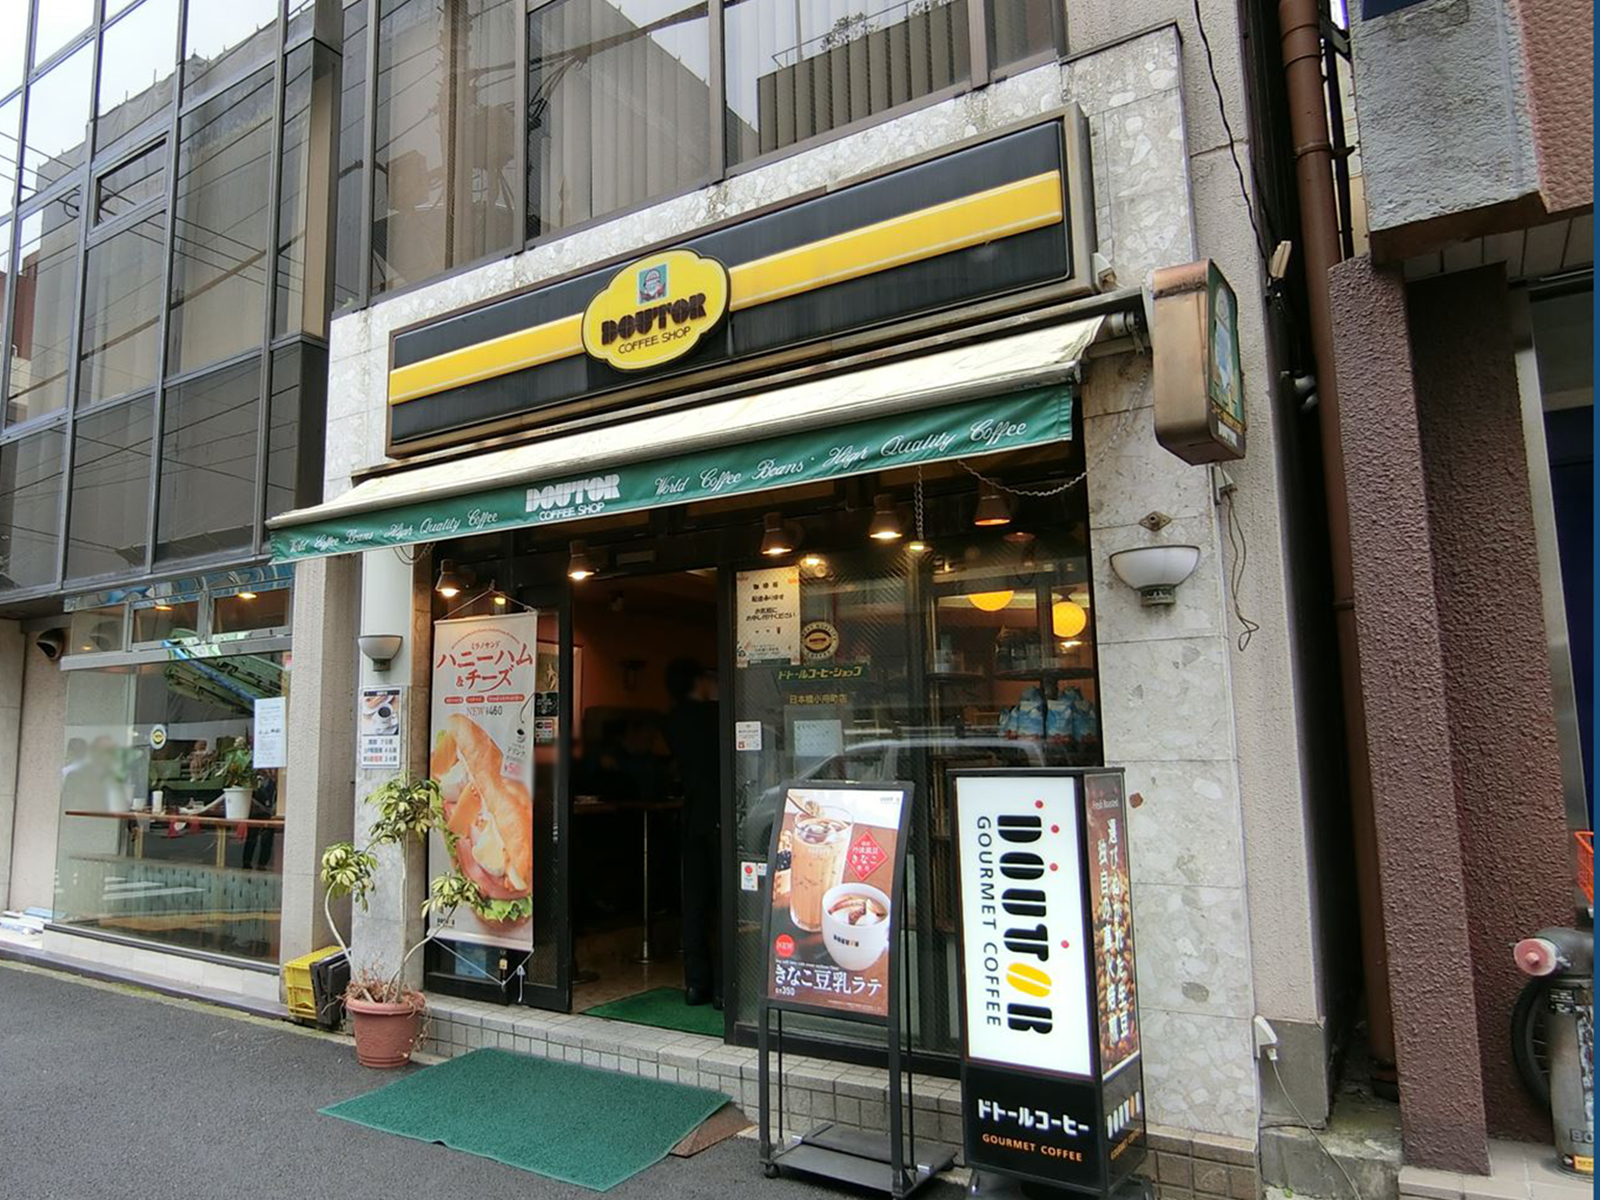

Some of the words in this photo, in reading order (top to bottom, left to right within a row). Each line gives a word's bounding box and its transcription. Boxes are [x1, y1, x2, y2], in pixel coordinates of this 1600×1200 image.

[601, 292, 707, 346] DOUTOR
[618, 335, 660, 354] COFFEE
[662, 325, 691, 344] SHOP
[654, 475, 688, 496] World
[699, 467, 743, 494] Coffee
[750, 458, 804, 481] Beans
[822, 445, 869, 469] High
[880, 431, 957, 457] Quality
[969, 418, 1028, 446] Coffee
[525, 473, 621, 513] DOUTOR
[345, 529, 374, 545] Beans
[383, 523, 413, 542] High
[419, 517, 462, 535] Quality
[467, 508, 498, 529] Coffee
[539, 507, 576, 522] COFFEE
[578, 501, 605, 516] SHOP
[436, 643, 534, 669] ハニーハム
[777, 665, 863, 681] ドトールコーヒーショップ
[1102, 798, 1119, 809] Roasted
[851, 853, 878, 865] きなこ
[976, 816, 997, 931] GOURMET
[997, 815, 1053, 1035] DOUTOR
[775, 964, 882, 997] きなこ豆乳ラテ
[983, 942, 1002, 1027] COFFEE
[977, 1098, 1090, 1137] ドトールコーヒー
[982, 1133, 1036, 1153] GOURMET
[1040, 1144, 1083, 1162] COFFEE
